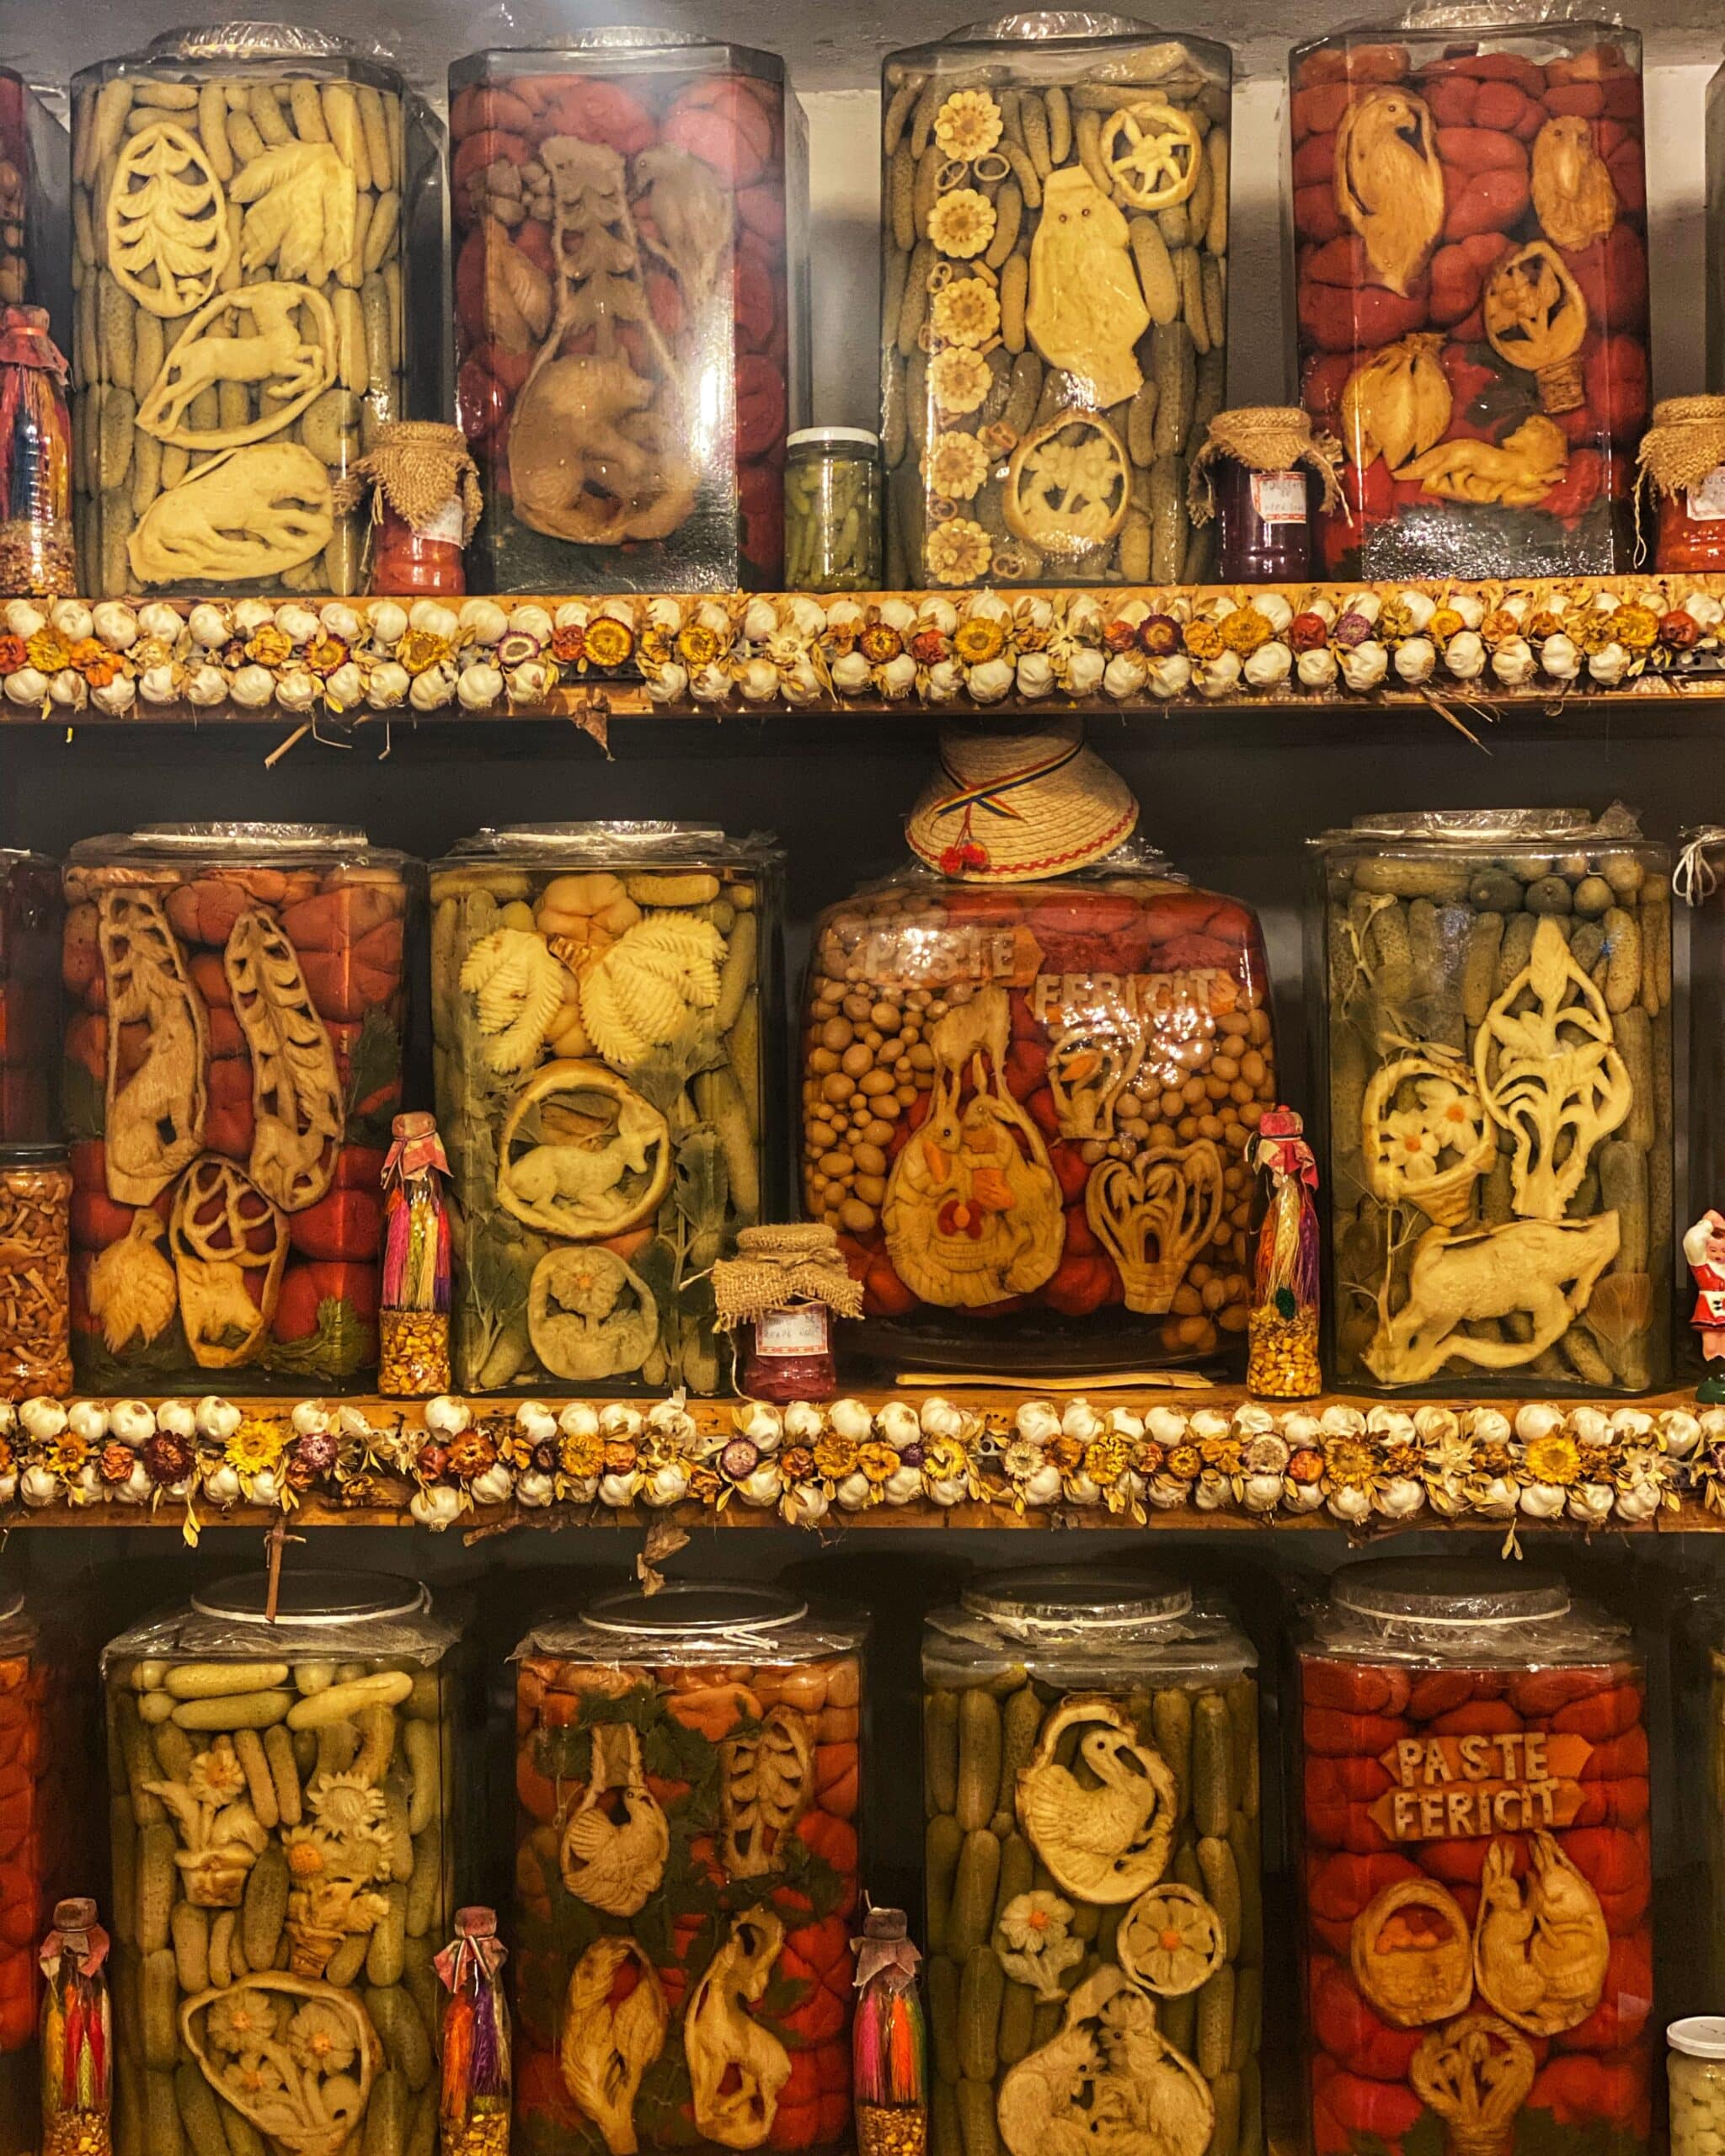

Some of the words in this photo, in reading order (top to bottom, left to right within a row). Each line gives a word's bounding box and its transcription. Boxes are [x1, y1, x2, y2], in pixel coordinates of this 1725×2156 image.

[1034, 969, 1216, 1022] FERICIT
[1397, 1732, 1548, 1788] PASTE
[1394, 1778, 1559, 1837] FERICIT
